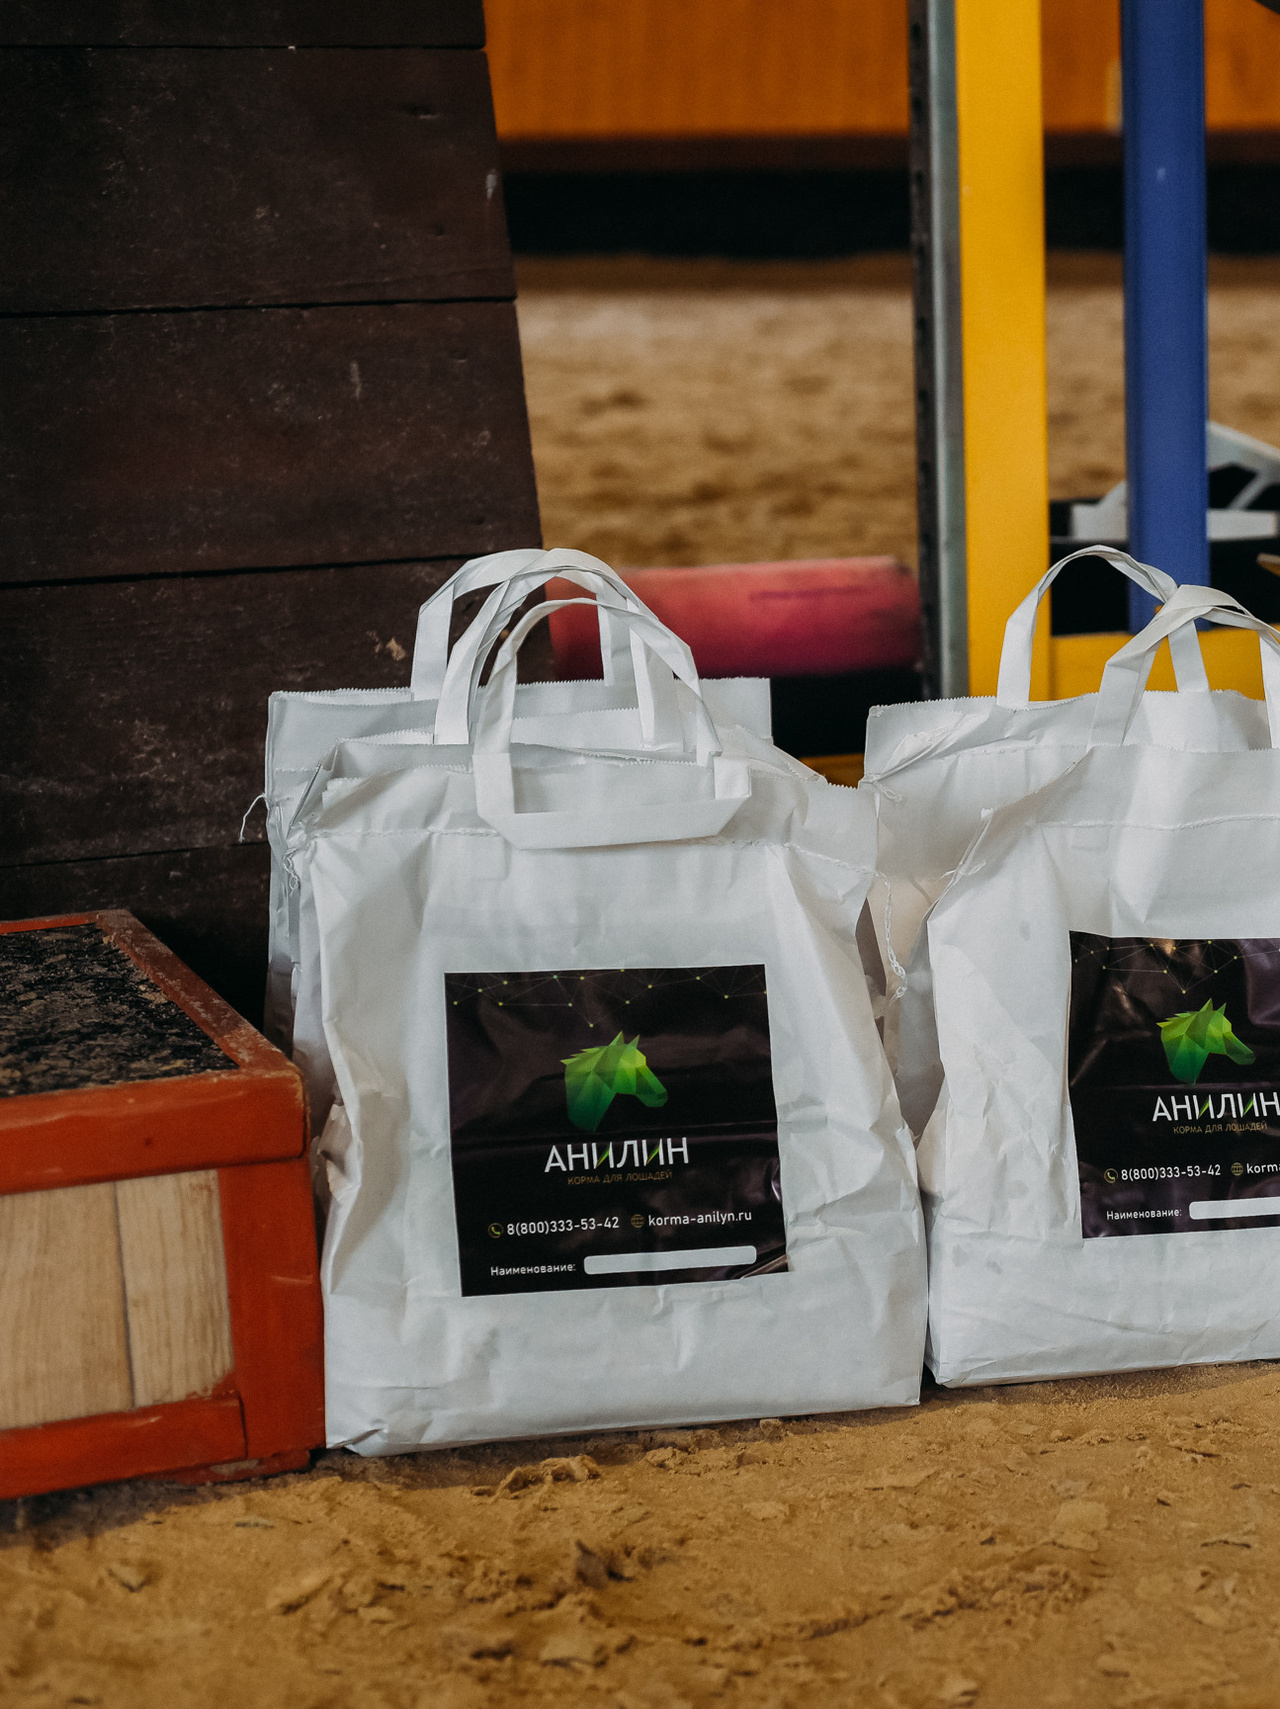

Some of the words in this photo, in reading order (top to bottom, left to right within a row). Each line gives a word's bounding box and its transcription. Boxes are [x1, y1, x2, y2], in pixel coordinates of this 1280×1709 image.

[1152, 1091, 1280, 1122] АНИЛИН
[1173, 1125, 1202, 1135] КОРМА
[1204, 1123, 1223, 1134] ДЛЯ
[1225, 1120, 1268, 1132] ЛОШАДЕЙ
[544, 1137, 689, 1173] АНИЛИН
[567, 1175, 600, 1185] КОРМА
[602, 1173, 623, 1184] ДЛЯ
[625, 1169, 673, 1182] ЛОШАДЕЙ
[1120, 1164, 1222, 1182] 8(800)333-53-42
[506, 1216, 620, 1236] 8(800)333-53-42
[648, 1210, 752, 1227] korma-anilyn.ru
[1106, 1208, 1182, 1221] Наименование:
[490, 1262, 576, 1277] Наименование:
